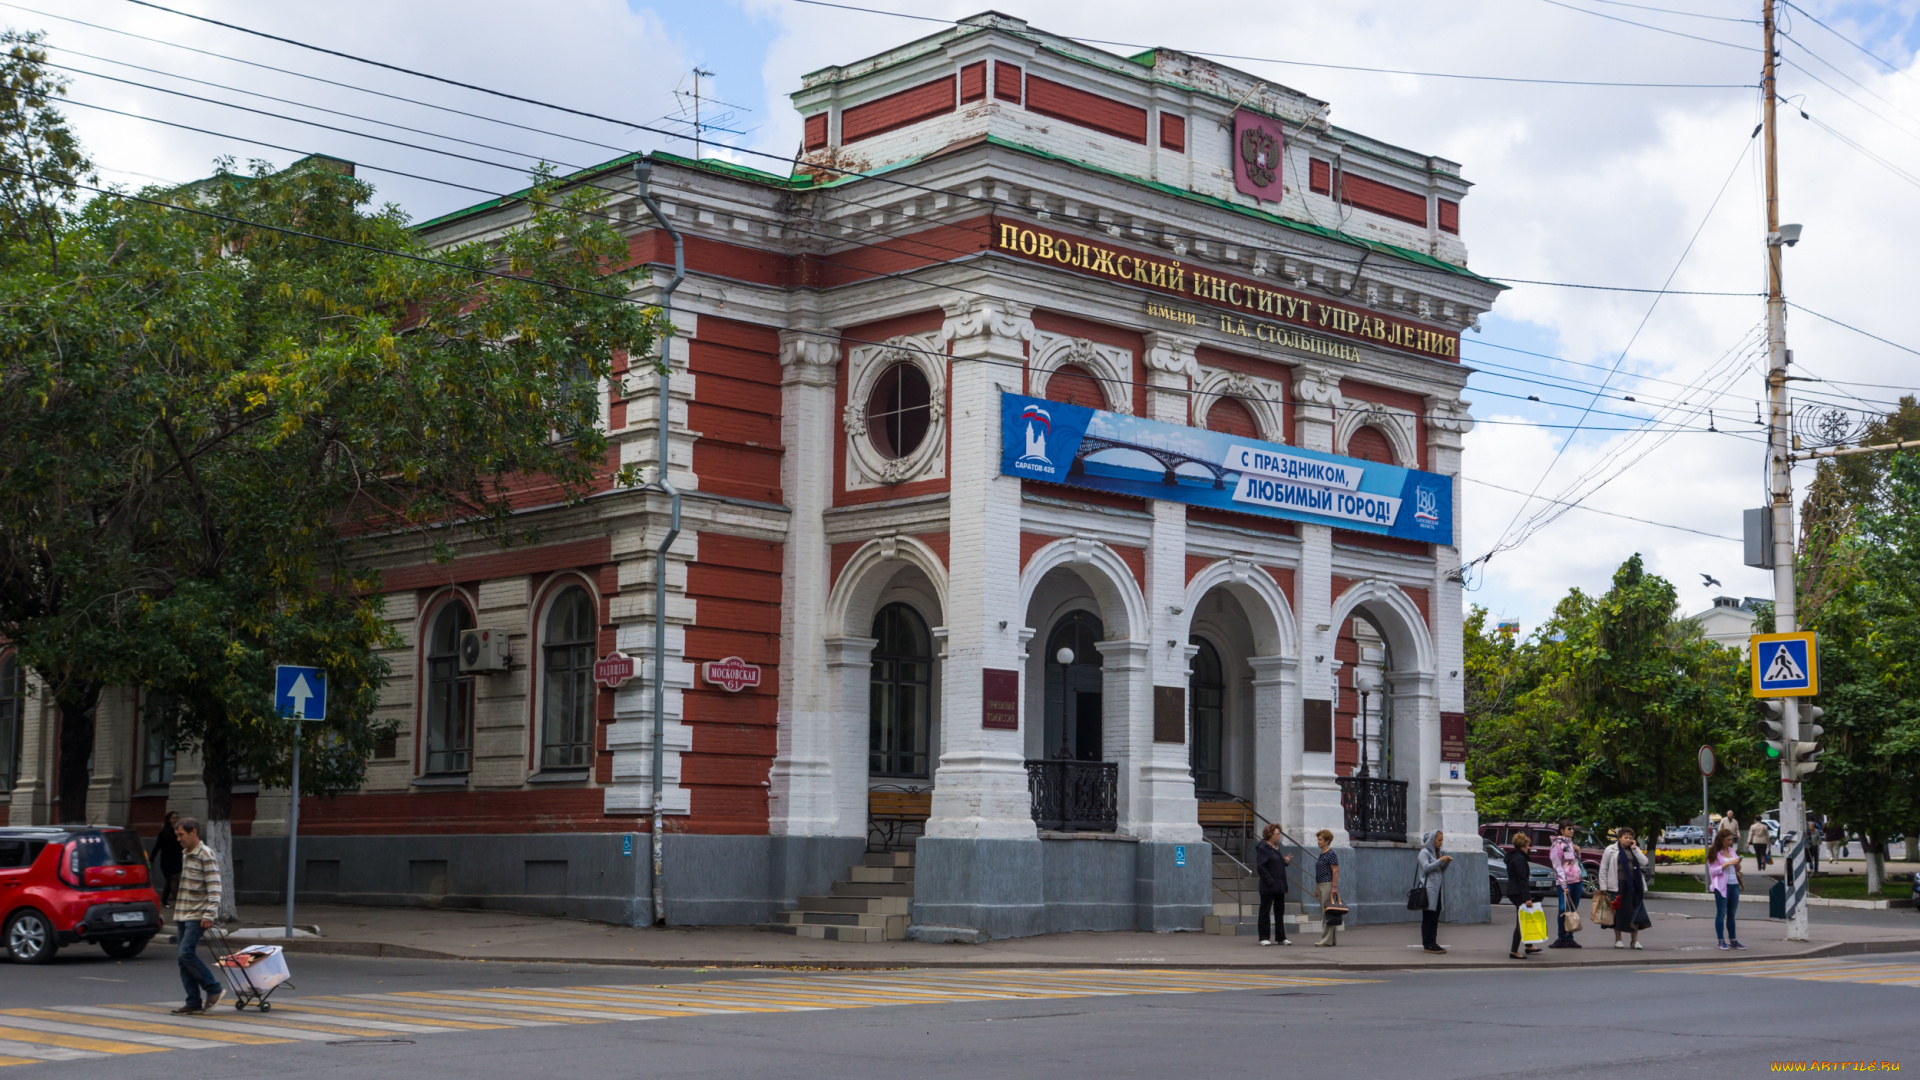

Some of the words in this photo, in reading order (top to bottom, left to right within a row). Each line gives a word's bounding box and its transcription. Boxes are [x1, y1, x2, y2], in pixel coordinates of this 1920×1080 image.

[1000, 223, 1185, 292] ПОВОЛЖСКИЙ
[1193, 272, 1311, 322] ИНСТИТУТ
[1318, 304, 1456, 357] УПРАВЛЕНИЯ
[1147, 302, 1196, 325] ИМЕНИ
[1220, 315, 1251, 338] П.А.
[1256, 323, 1360, 362] СТОЛЫПИНА
[1015, 461, 1043, 472] САРАТОВ
[1043, 466, 1055, 474] 426
[1241, 451, 1249, 467] С
[1254, 453, 1350, 487] ПРАЗДНИКОМ,
[1246, 478, 1332, 511] ЛЮБИМЫЙ
[1338, 494, 1390, 523] ГОРОД!
[600, 663, 629, 676] РАДИЩЕВА
[711, 667, 756, 681] МОСКОВСКАЯ
[727, 680, 739, 689] 61
